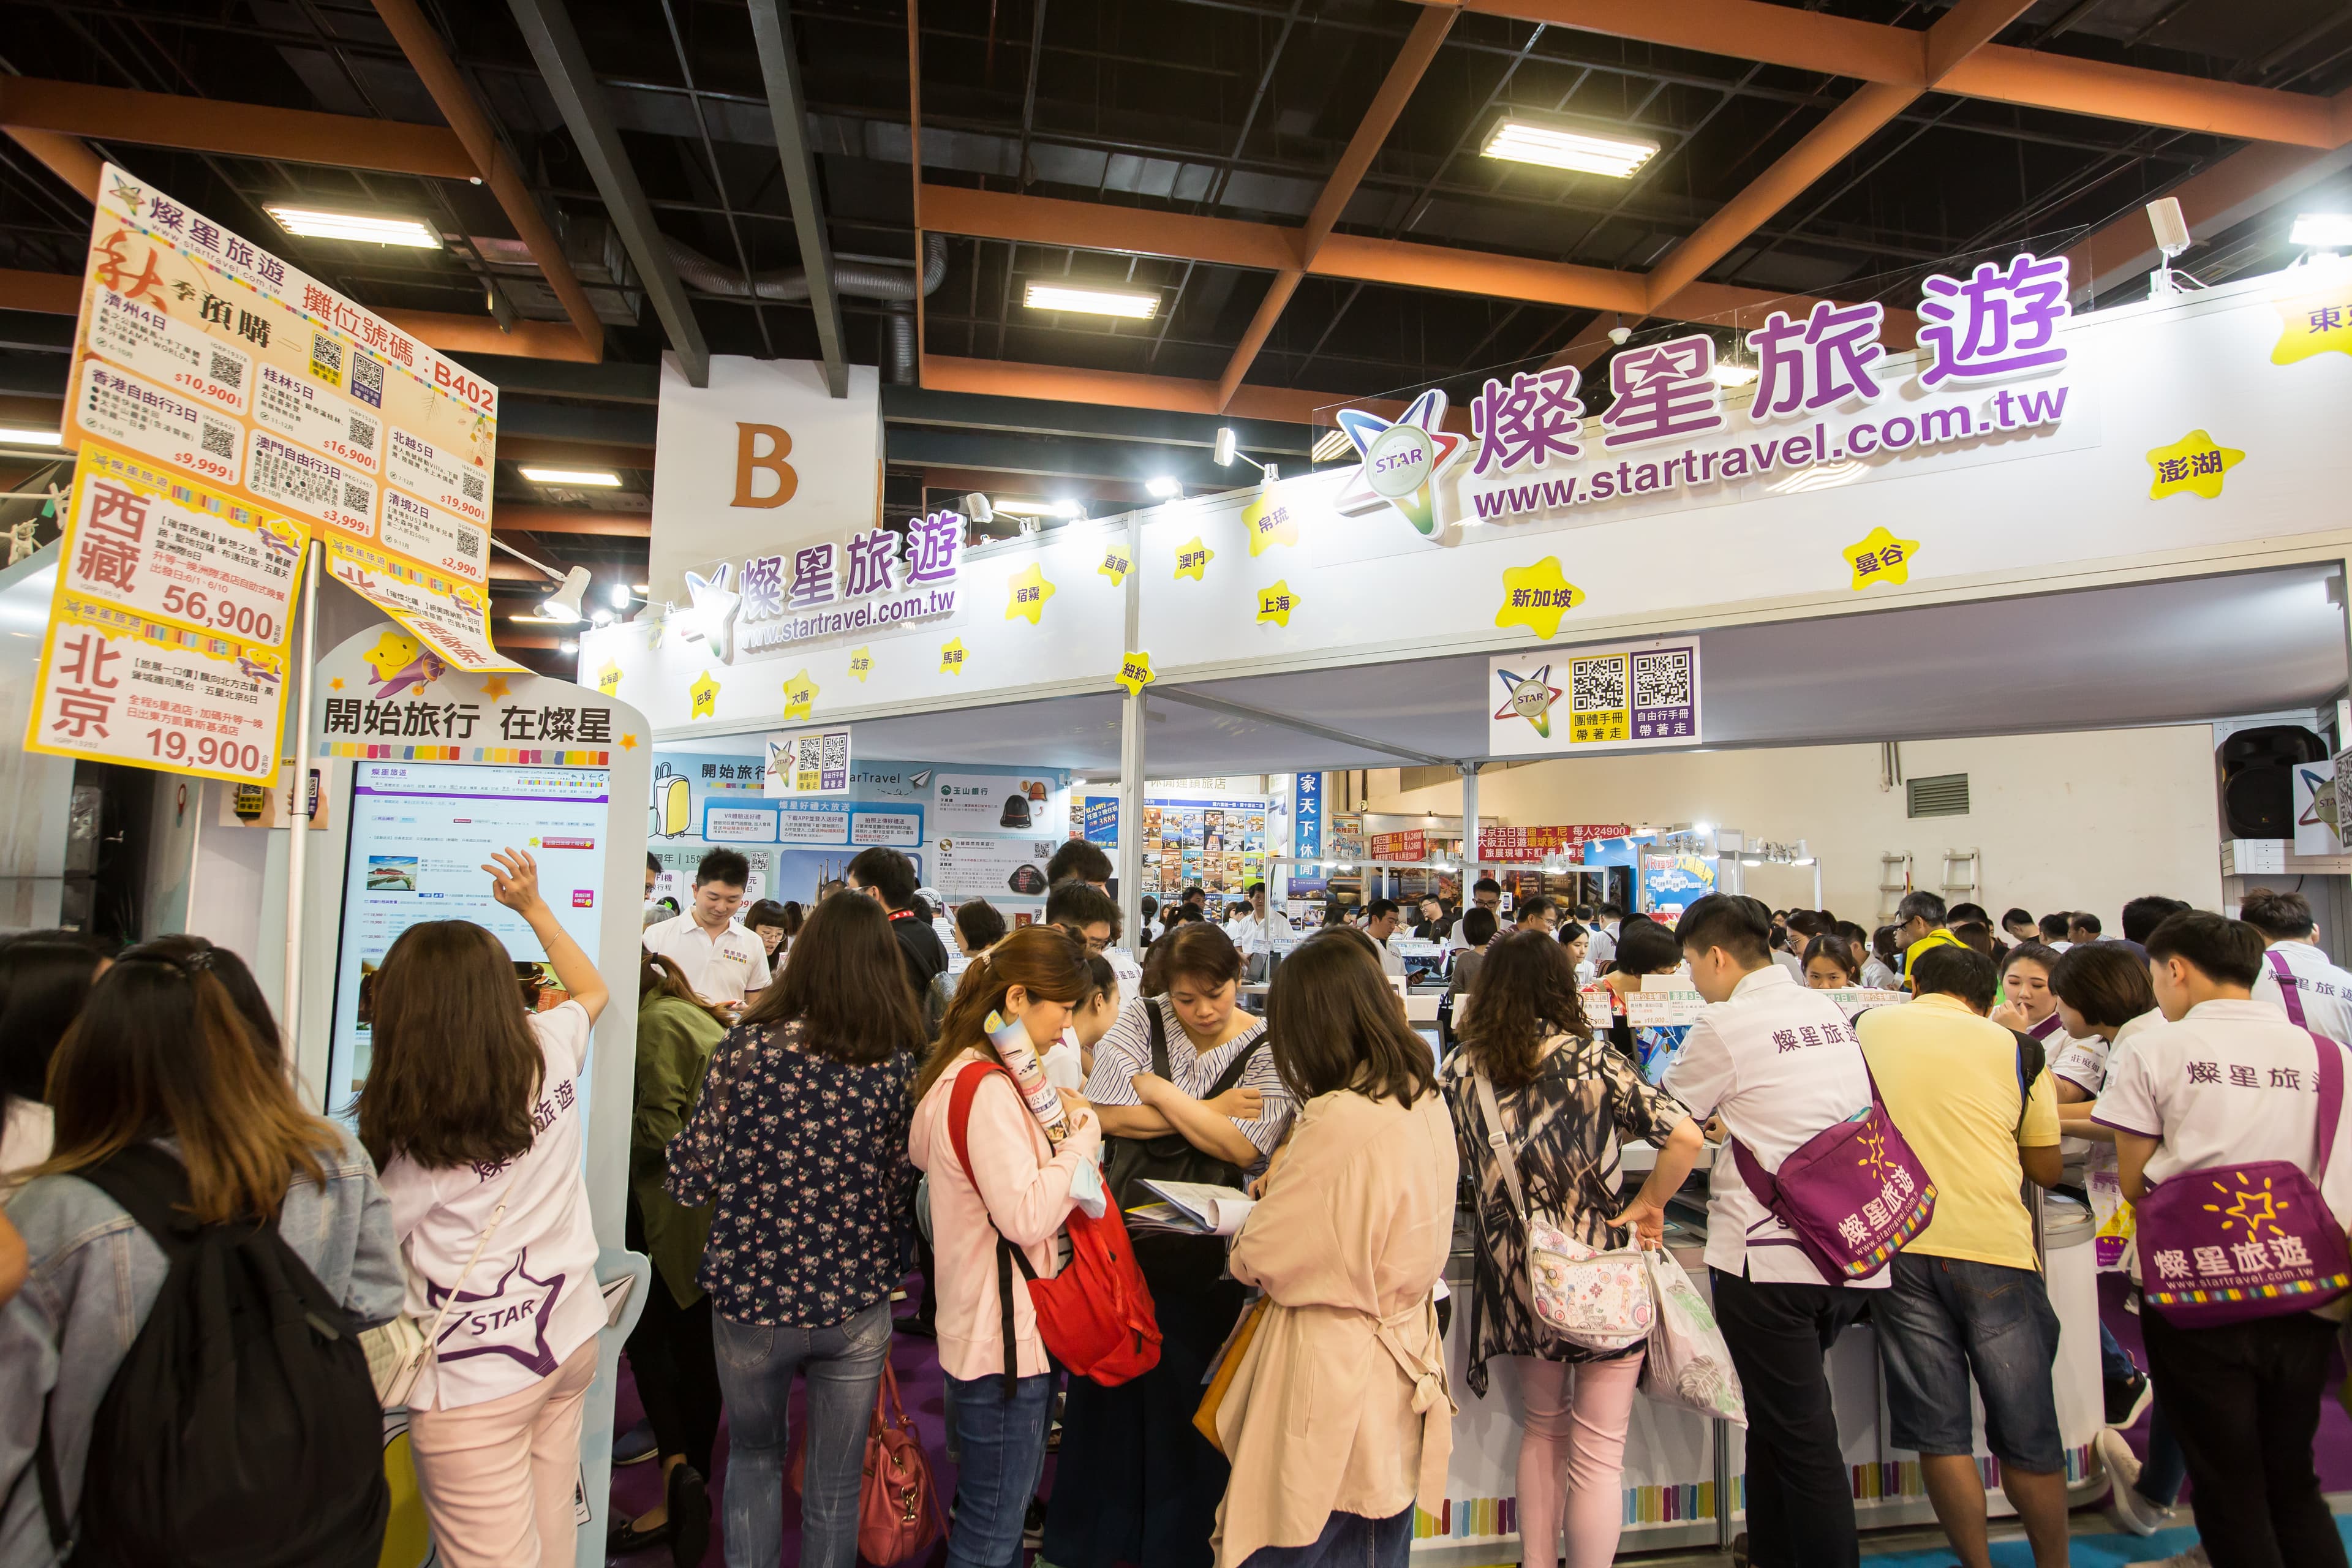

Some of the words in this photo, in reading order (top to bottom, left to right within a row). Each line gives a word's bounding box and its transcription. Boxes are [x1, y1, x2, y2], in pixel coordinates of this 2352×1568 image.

[150, 195, 285, 287] 燦星旅遊
[152, 224, 282, 295] www.startravel.com.tw
[104, 291, 166, 331] 濟州4日
[2308, 304, 2352, 334] 東
[1472, 255, 2068, 475] 燦星旅遊
[175, 372, 236, 405] $10,900
[263, 367, 314, 400] 桂林5日
[92, 368, 198, 424] 香港自由行3日
[323, 440, 373, 467] $16,900
[393, 431, 434, 459] 北越5日
[1473, 386, 2069, 518] www.startravel.com.tw
[175, 452, 227, 478] $9,999
[256, 434, 341, 481] 澳門自由行3日
[729, 421, 799, 508] B
[1375, 447, 1423, 474] STAR
[2157, 449, 2223, 484] 澎湖
[388, 491, 430, 519] 清境2日
[440, 494, 481, 518] $19,900
[323, 510, 365, 532] $3,999
[1258, 506, 1290, 534] 帛琉
[77, 481, 151, 594] 西藏
[345, 543, 385, 567] 燦星旅遊
[739, 511, 963, 614] 燦星旅遊
[1104, 554, 1129, 574] 首爾
[1179, 551, 1205, 570] 澳門
[1855, 544, 1904, 578] 曼谷
[442, 557, 477, 578] $2,990
[1017, 586, 1040, 603] 宿霧
[1261, 595, 1291, 614] 上海
[1512, 587, 1573, 608] 新加坡
[162, 584, 273, 640] 56,900
[737, 588, 956, 647] www.startravel.com.tw
[851, 658, 869, 671] 北京
[943, 649, 963, 665] 馬祖
[600, 672, 619, 687] 北海道
[1123, 662, 1147, 682] 紐約
[52, 633, 122, 739] 北京
[696, 688, 712, 706] 巴黎
[791, 689, 809, 706] 大阪
[1517, 691, 1544, 704] STAR
[323, 698, 481, 739] 開始旅行
[500, 706, 612, 744] 在燦星
[1574, 711, 1624, 726] 團體手冊
[1637, 709, 1689, 722] 自由行手冊
[1576, 726, 1623, 741] 帶著走
[1638, 722, 1687, 737] 帶著走
[146, 728, 260, 773] 19,900
[371, 768, 407, 777] 燦星旅遊
[701, 763, 765, 780] 開始旅行
[849, 772, 900, 784] arTravel
[798, 772, 819, 782] 團體手冊
[823, 771, 845, 780] 自由行手冊
[823, 779, 843, 789] 帶著走
[799, 782, 818, 790] 帶著走
[953, 786, 989, 796] 玉山銀行
[778, 800, 851, 812] 燦星好禮大放送
[2319, 797, 2336, 808] STA
[1099, 813, 1116, 826] 3888
[1299, 774, 1316, 876] 家天下休閒
[1573, 826, 1626, 837] 每人24900
[1485, 848, 1543, 858] 旅展現場下訂
[655, 873, 673, 882] FI機
[471, 1079, 575, 1183] 燦旅遊
[1838, 1164, 1915, 1248] 燦星旅遊
[2153, 1235, 2313, 1279] 燦星旅遊
[2166, 1267, 2314, 1290] www.startravel.com.tw
[470, 1298, 535, 1336] STAR
